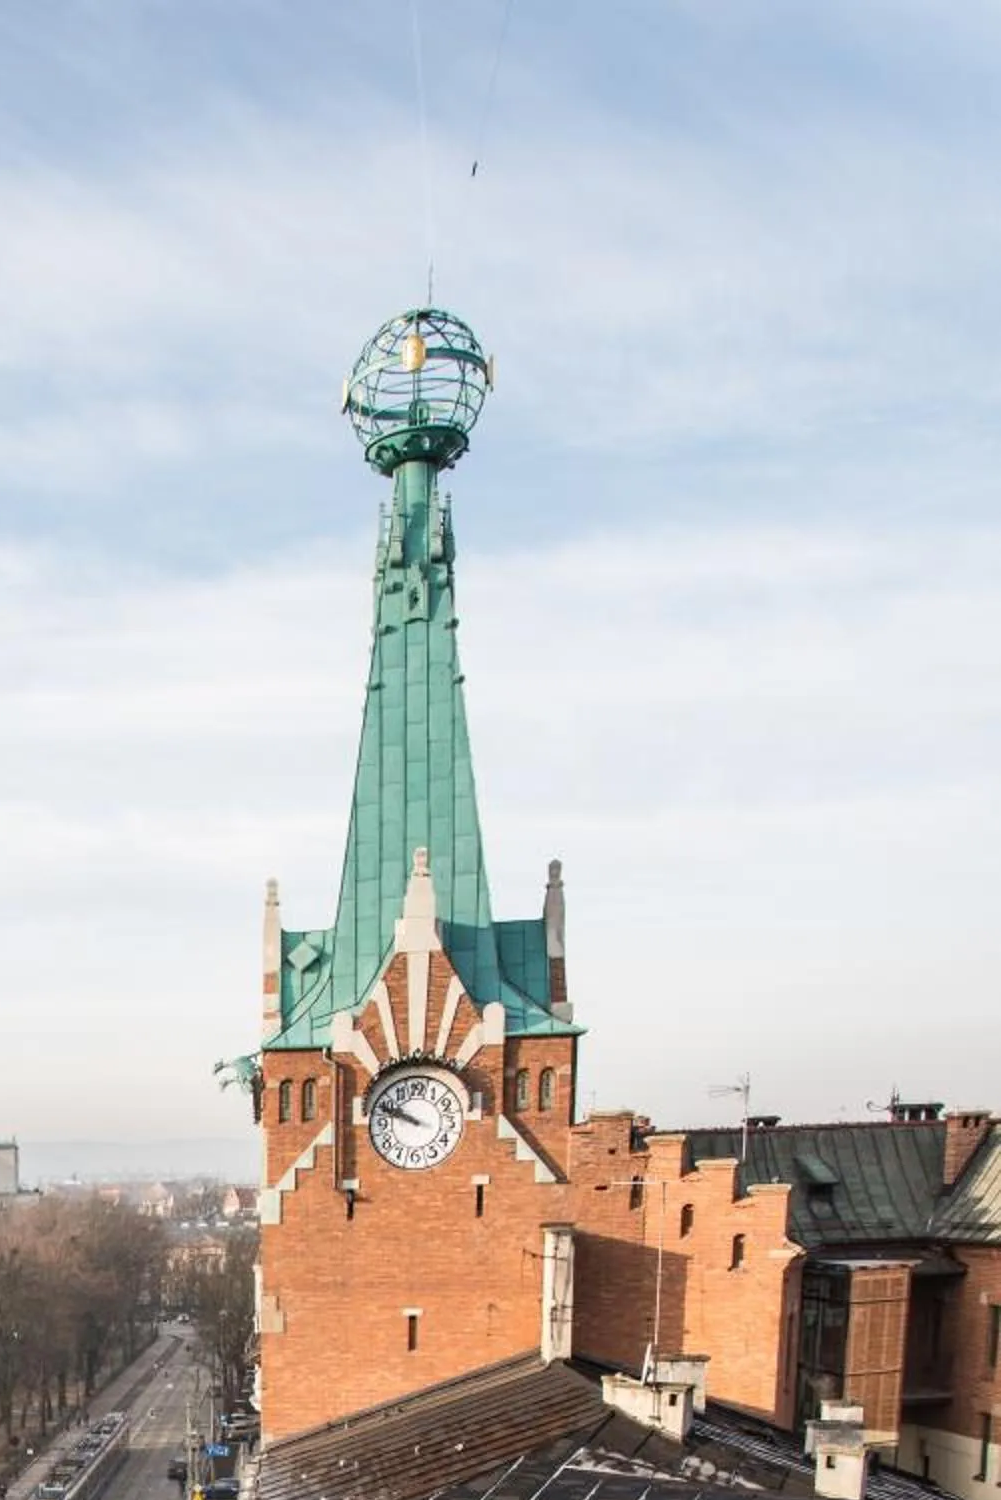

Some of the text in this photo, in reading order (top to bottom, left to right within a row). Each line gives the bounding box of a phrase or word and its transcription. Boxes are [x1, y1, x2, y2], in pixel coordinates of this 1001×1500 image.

[395, 1086, 406, 1101] 11
[410, 1081, 425, 1098] 12
[430, 1087, 437, 1101] 1
[441, 1098, 452, 1112] 2
[377, 1117, 388, 1131] 9
[444, 1114, 456, 1129] 3
[382, 1132, 392, 1149] 8
[439, 1133, 449, 1147] 4
[395, 1147, 404, 1160] 7
[410, 1149, 422, 1164] 6
[426, 1145, 438, 1159] 5
